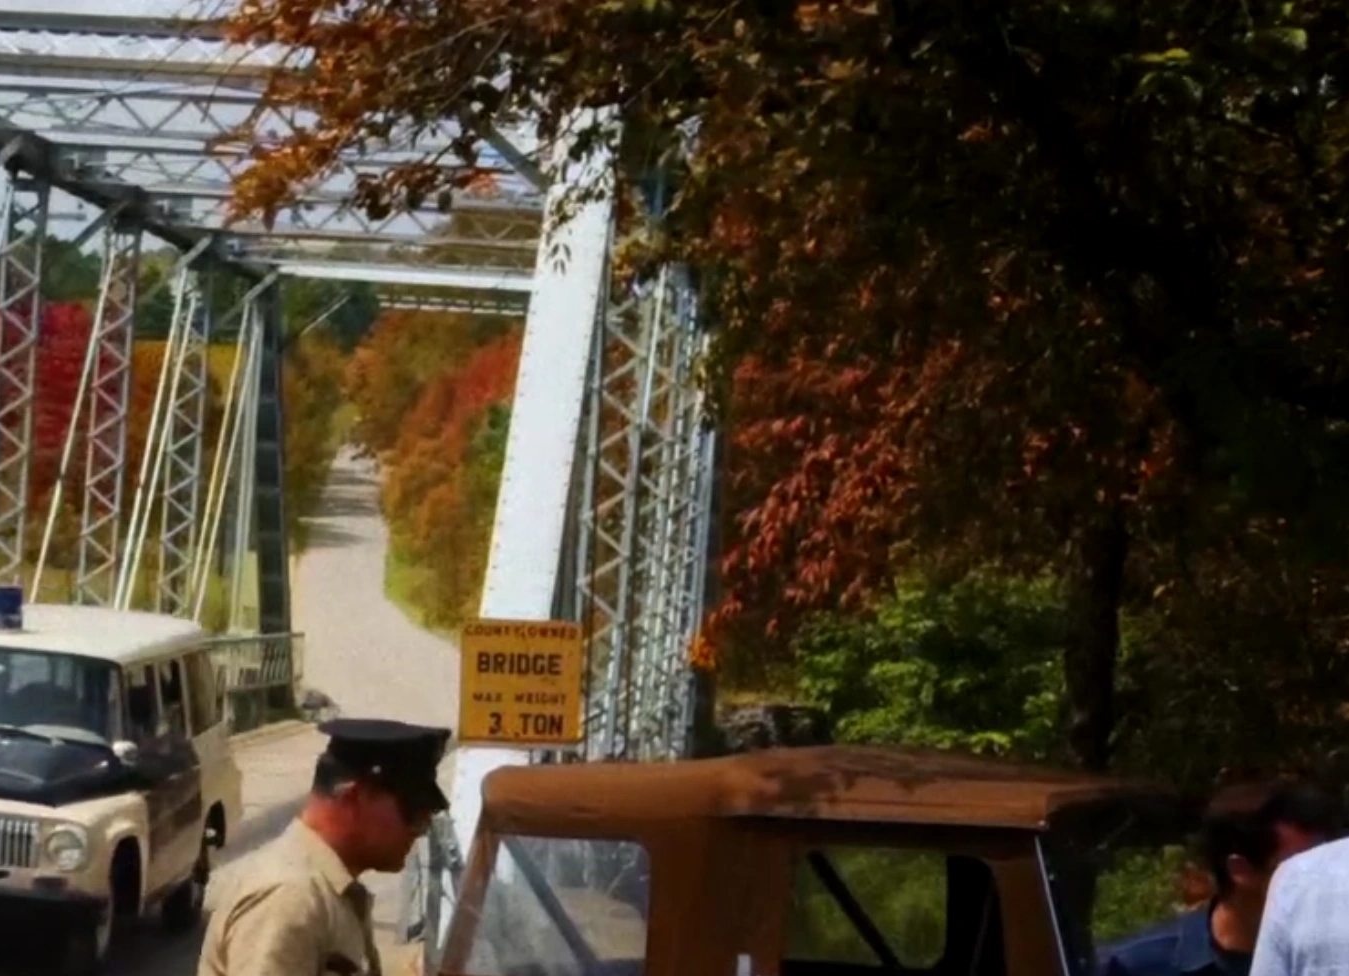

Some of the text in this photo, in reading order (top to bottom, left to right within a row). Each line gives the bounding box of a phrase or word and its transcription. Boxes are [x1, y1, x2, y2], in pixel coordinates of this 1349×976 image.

[477, 652, 562, 675] BRIDGE
[515, 692, 566, 705] WEIGHT
[488, 712, 563, 735] 3 TON
